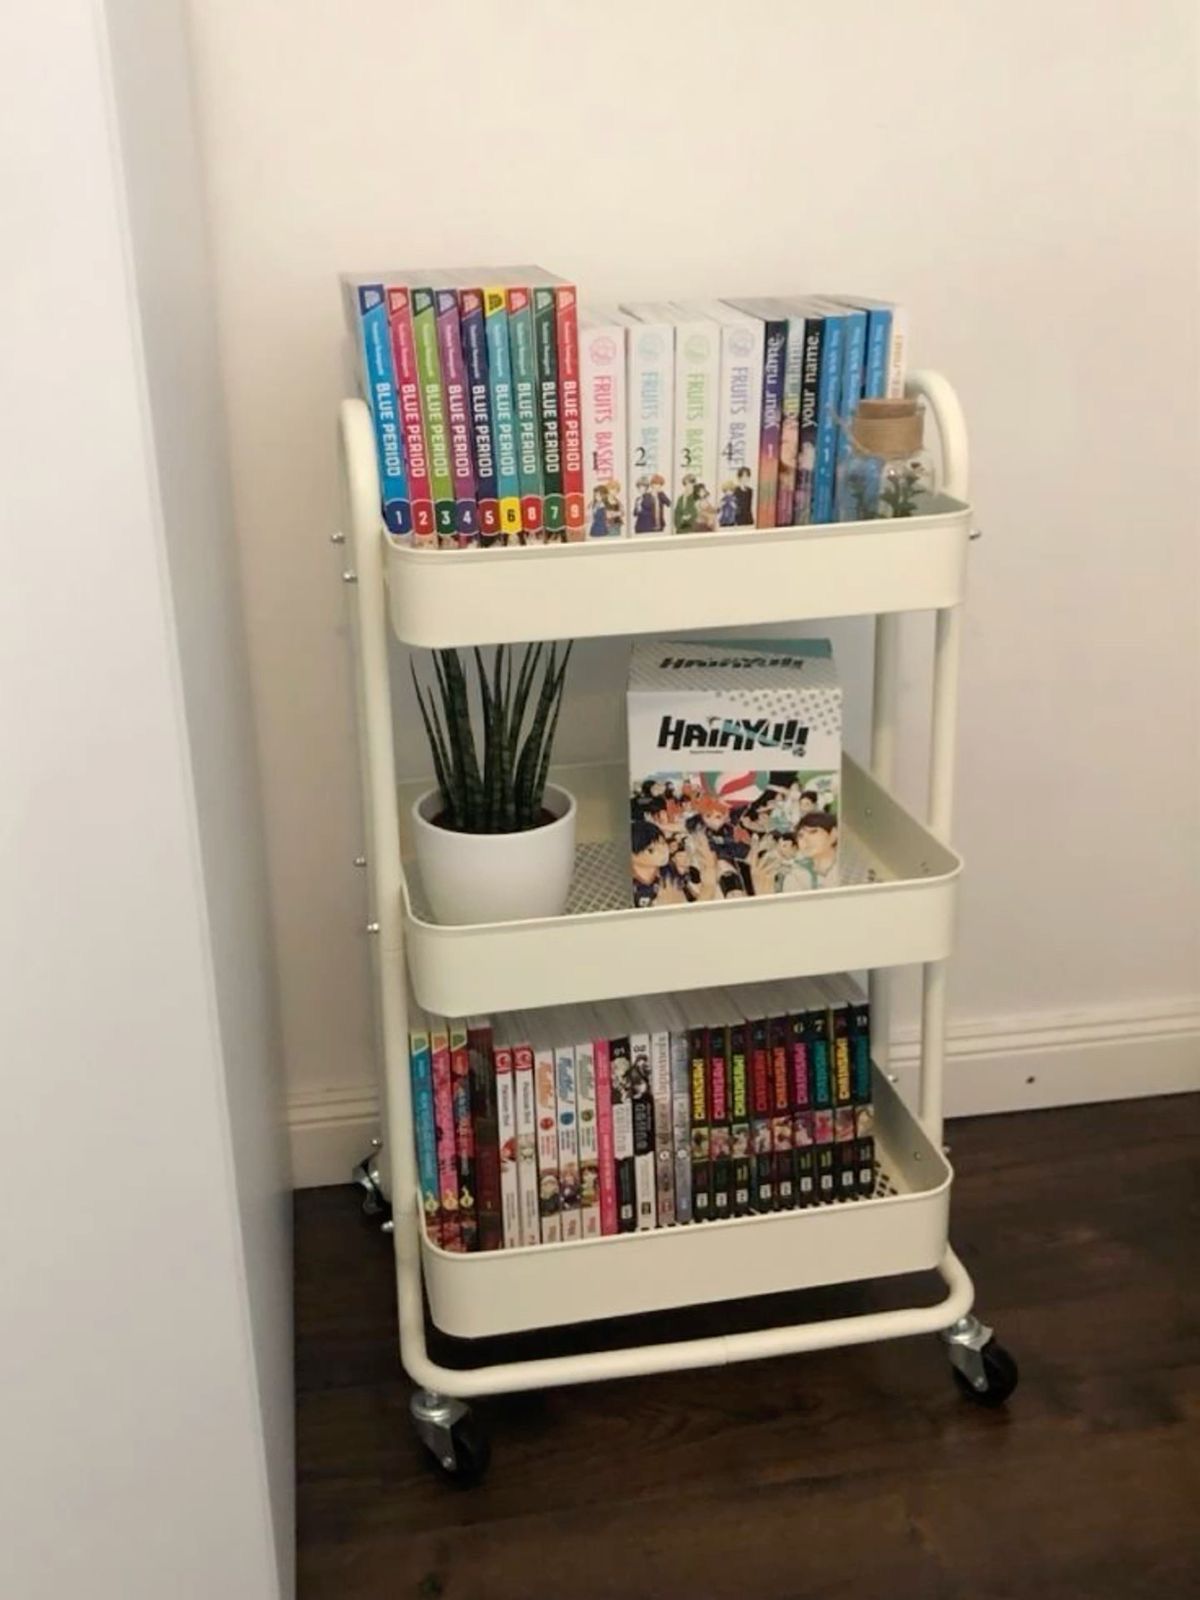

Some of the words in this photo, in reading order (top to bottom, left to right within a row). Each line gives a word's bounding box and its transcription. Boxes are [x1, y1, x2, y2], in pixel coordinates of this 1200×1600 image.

[805, 332, 820, 383] name.
[376, 383, 394, 420] BLUE
[401, 384, 419, 422] BLUE
[425, 384, 442, 421] BLUE
[448, 384, 465, 422] BLUE
[472, 385, 488, 422] BLUE
[495, 384, 511, 421] BLUE
[517, 383, 533, 419] BLUE
[542, 382, 557, 418] BLUE
[564, 381, 578, 417] BLUE
[593, 376, 612, 424] FRUITS
[641, 372, 659, 420] FRUITS
[687, 374, 704, 421] FRUITS
[730, 367, 749, 415] FRUITS
[764, 390, 780, 429] your
[802, 390, 818, 428] your
[382, 423, 401, 477] PERIOD
[406, 425, 425, 477] PERIOD
[431, 425, 449, 477] PERIOD
[452, 425, 470, 477] PERIOD
[475, 425, 493, 477] PERIOD
[499, 424, 515, 476] PERIOD
[520, 422, 536, 474] PERIOD
[544, 422, 559, 473] PERIOD
[565, 421, 580, 471] PERIOD
[592, 451, 598, 470] 1
[595, 431, 614, 482] BASKET
[635, 447, 646, 466] 2
[681, 448, 692, 467] 3
[396, 511, 403, 524] 1
[419, 511, 428, 525] 2
[441, 511, 450, 524] 3
[463, 511, 472, 524] 4
[485, 511, 494, 524] 5
[507, 509, 516, 522] 6
[528, 507, 536, 520] 8
[550, 506, 558, 519] 7
[571, 504, 580, 517] 9
[814, 1019, 824, 1031] 7
